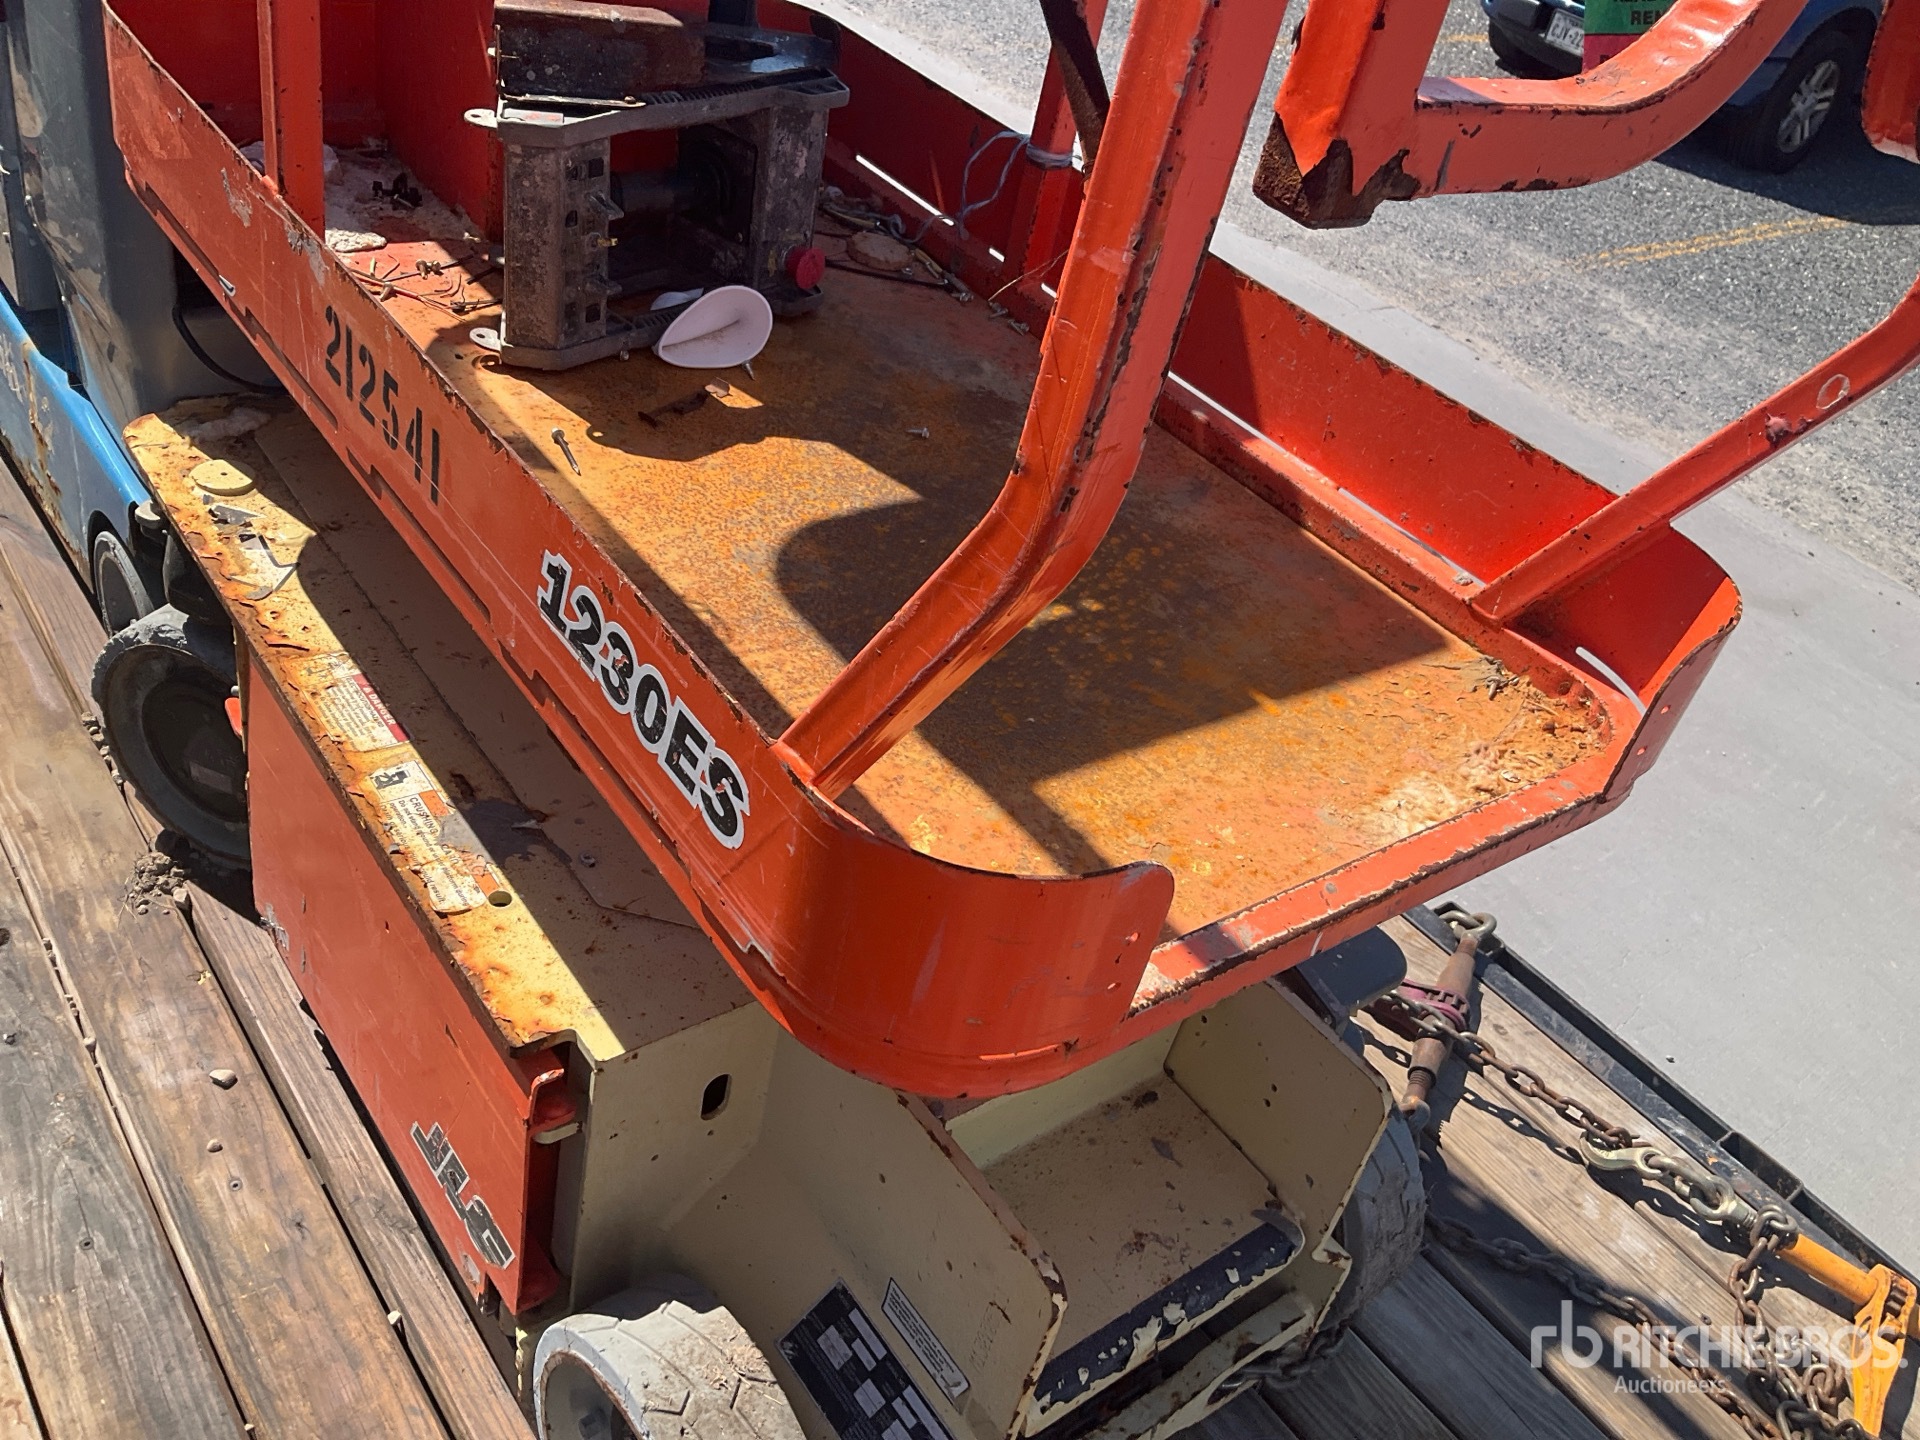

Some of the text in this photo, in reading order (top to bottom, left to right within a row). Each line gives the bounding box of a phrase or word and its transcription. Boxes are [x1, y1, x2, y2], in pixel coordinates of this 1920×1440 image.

[325, 306, 440, 505] 212541
[368, 693, 396, 725] DANGER
[537, 549, 750, 849] 1230ES
[409, 797, 438, 834] CRUSHING
[410, 1121, 516, 1270] JLG
